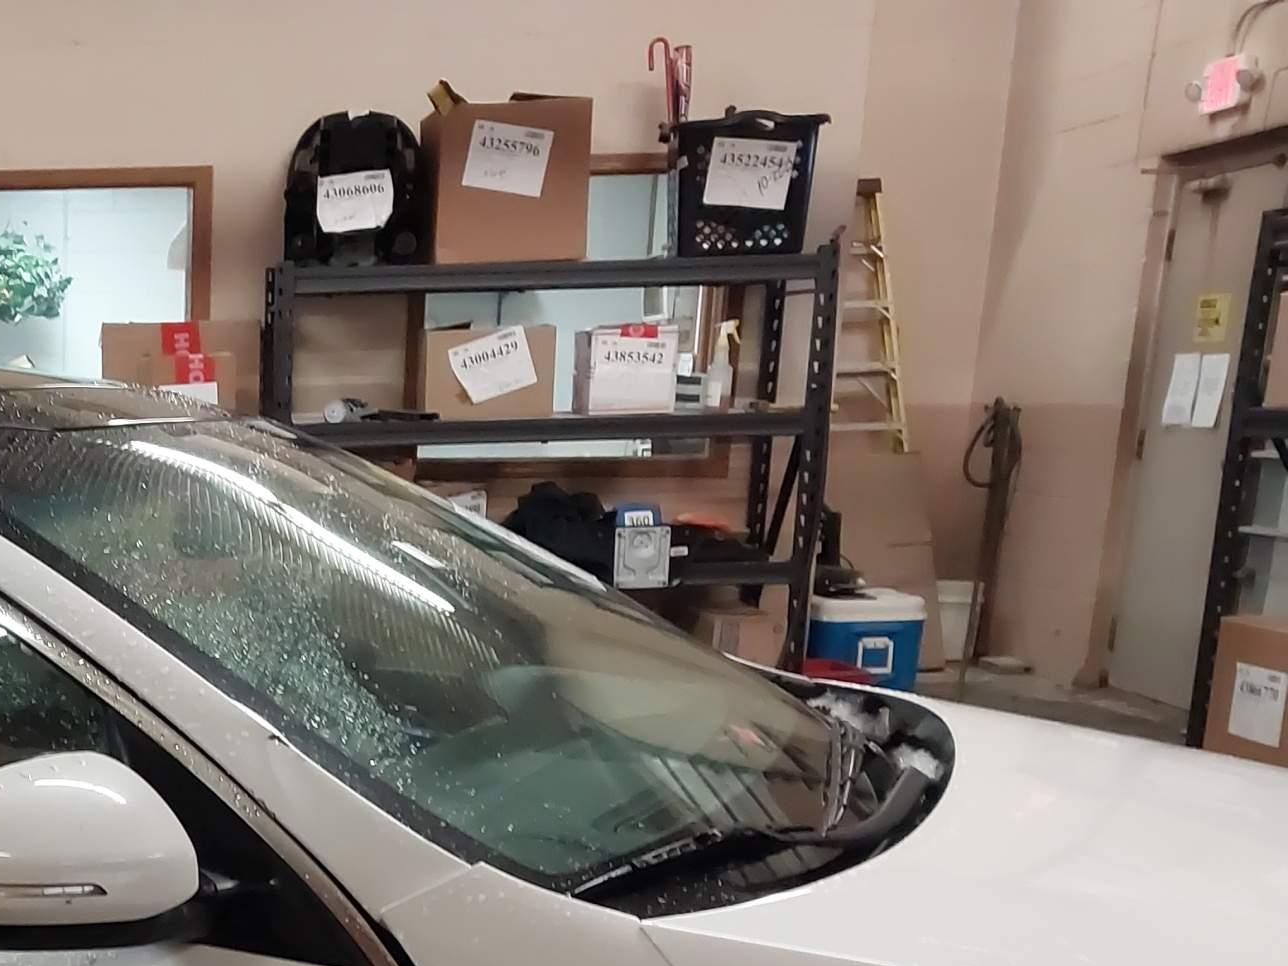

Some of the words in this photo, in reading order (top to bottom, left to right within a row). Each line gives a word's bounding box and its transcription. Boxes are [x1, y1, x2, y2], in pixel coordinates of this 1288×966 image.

[720, 152, 784, 169] 43522454
[323, 183, 385, 199] 43068606
[461, 340, 519, 369] 43004429
[604, 350, 664, 364] 43853542
